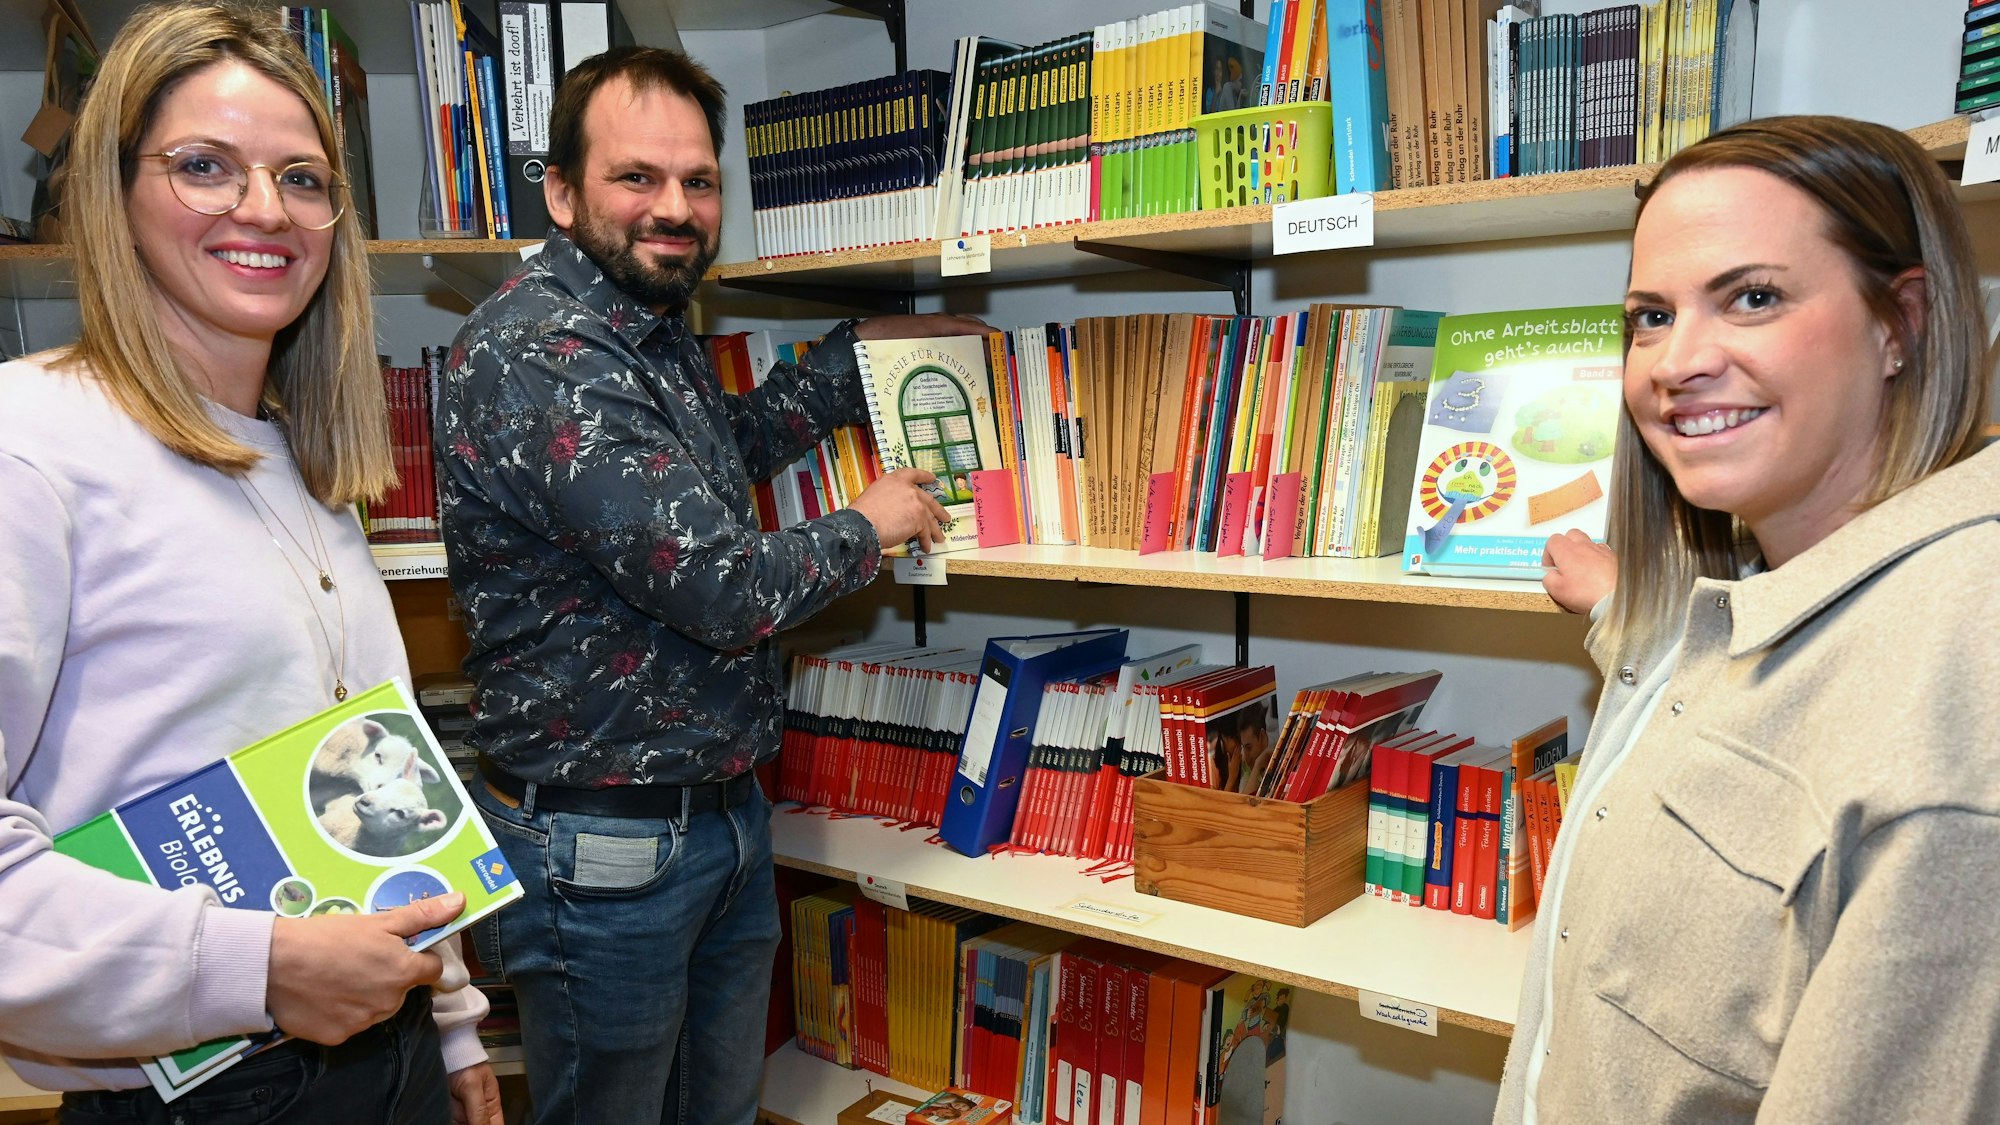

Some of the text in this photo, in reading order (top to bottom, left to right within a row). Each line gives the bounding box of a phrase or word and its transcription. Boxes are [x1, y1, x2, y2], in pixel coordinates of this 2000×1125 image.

[509, 61, 521, 76] ist
[333, 75, 341, 106] Wirtschaft
[1260, 84, 1270, 107] rtstark
[1277, 84, 1285, 104] tstark
[1289, 80, 1298, 103] rtstark
[1311, 79, 1320, 101] rtstark
[1455, 103, 1463, 124] Ruhr
[1345, 117, 1356, 182] Schroedel wortstark
[1429, 109, 1441, 186] Verlag an der Ruhr
[1456, 127, 1464, 141] der
[1458, 144, 1464, 155] an
[1288, 215, 1358, 235] DEUTSCH
[1451, 318, 1619, 346] Ohne Arbeitsblatt
[1484, 337, 1604, 368] geht's auch!
[883, 347, 978, 397] POESIE FÜR KINDER
[921, 382, 948, 390] Sprachspiele
[1579, 369, 1604, 379] Band
[1300, 475, 1309, 493] Ruhr
[976, 496, 985, 536] Schuljahr
[1112, 504, 1118, 513] an
[1144, 502, 1153, 543] Schuljahr
[1221, 500, 1233, 546] Schuljahr
[1299, 507, 1305, 517] an
[950, 534, 978, 542] Mildenber
[1111, 514, 1119, 535] Verlag
[1266, 505, 1276, 556] Schuljahr
[1294, 518, 1304, 540] Verlag
[1454, 544, 1477, 555] Mehr
[1480, 544, 1529, 558] praktische
[378, 565, 450, 577] ienerziehung
[1163, 728, 1173, 777] deutsch.kombi
[1176, 728, 1186, 779] deutsch.kombi
[1188, 734, 1199, 781] deutsch.kombi
[1197, 736, 1208, 784] deutsch.kombi
[1534, 744, 1564, 770] DUDEN
[1459, 786, 1470, 848] Fehlerfrei schreiben
[1479, 787, 1492, 849] Fehlerfrei schreiben
[1501, 798, 1511, 849] Wörterbuch
[160, 839, 199, 887] Biolo
[169, 793, 246, 904] ERLEBNIS
[475, 858, 499, 891] Schroedel
[1060, 965, 1069, 1001] Schwester
[1078, 973, 1087, 1009] Schwester
[1104, 978, 1114, 1014] Schwester
[1130, 983, 1138, 1020] Schwester
